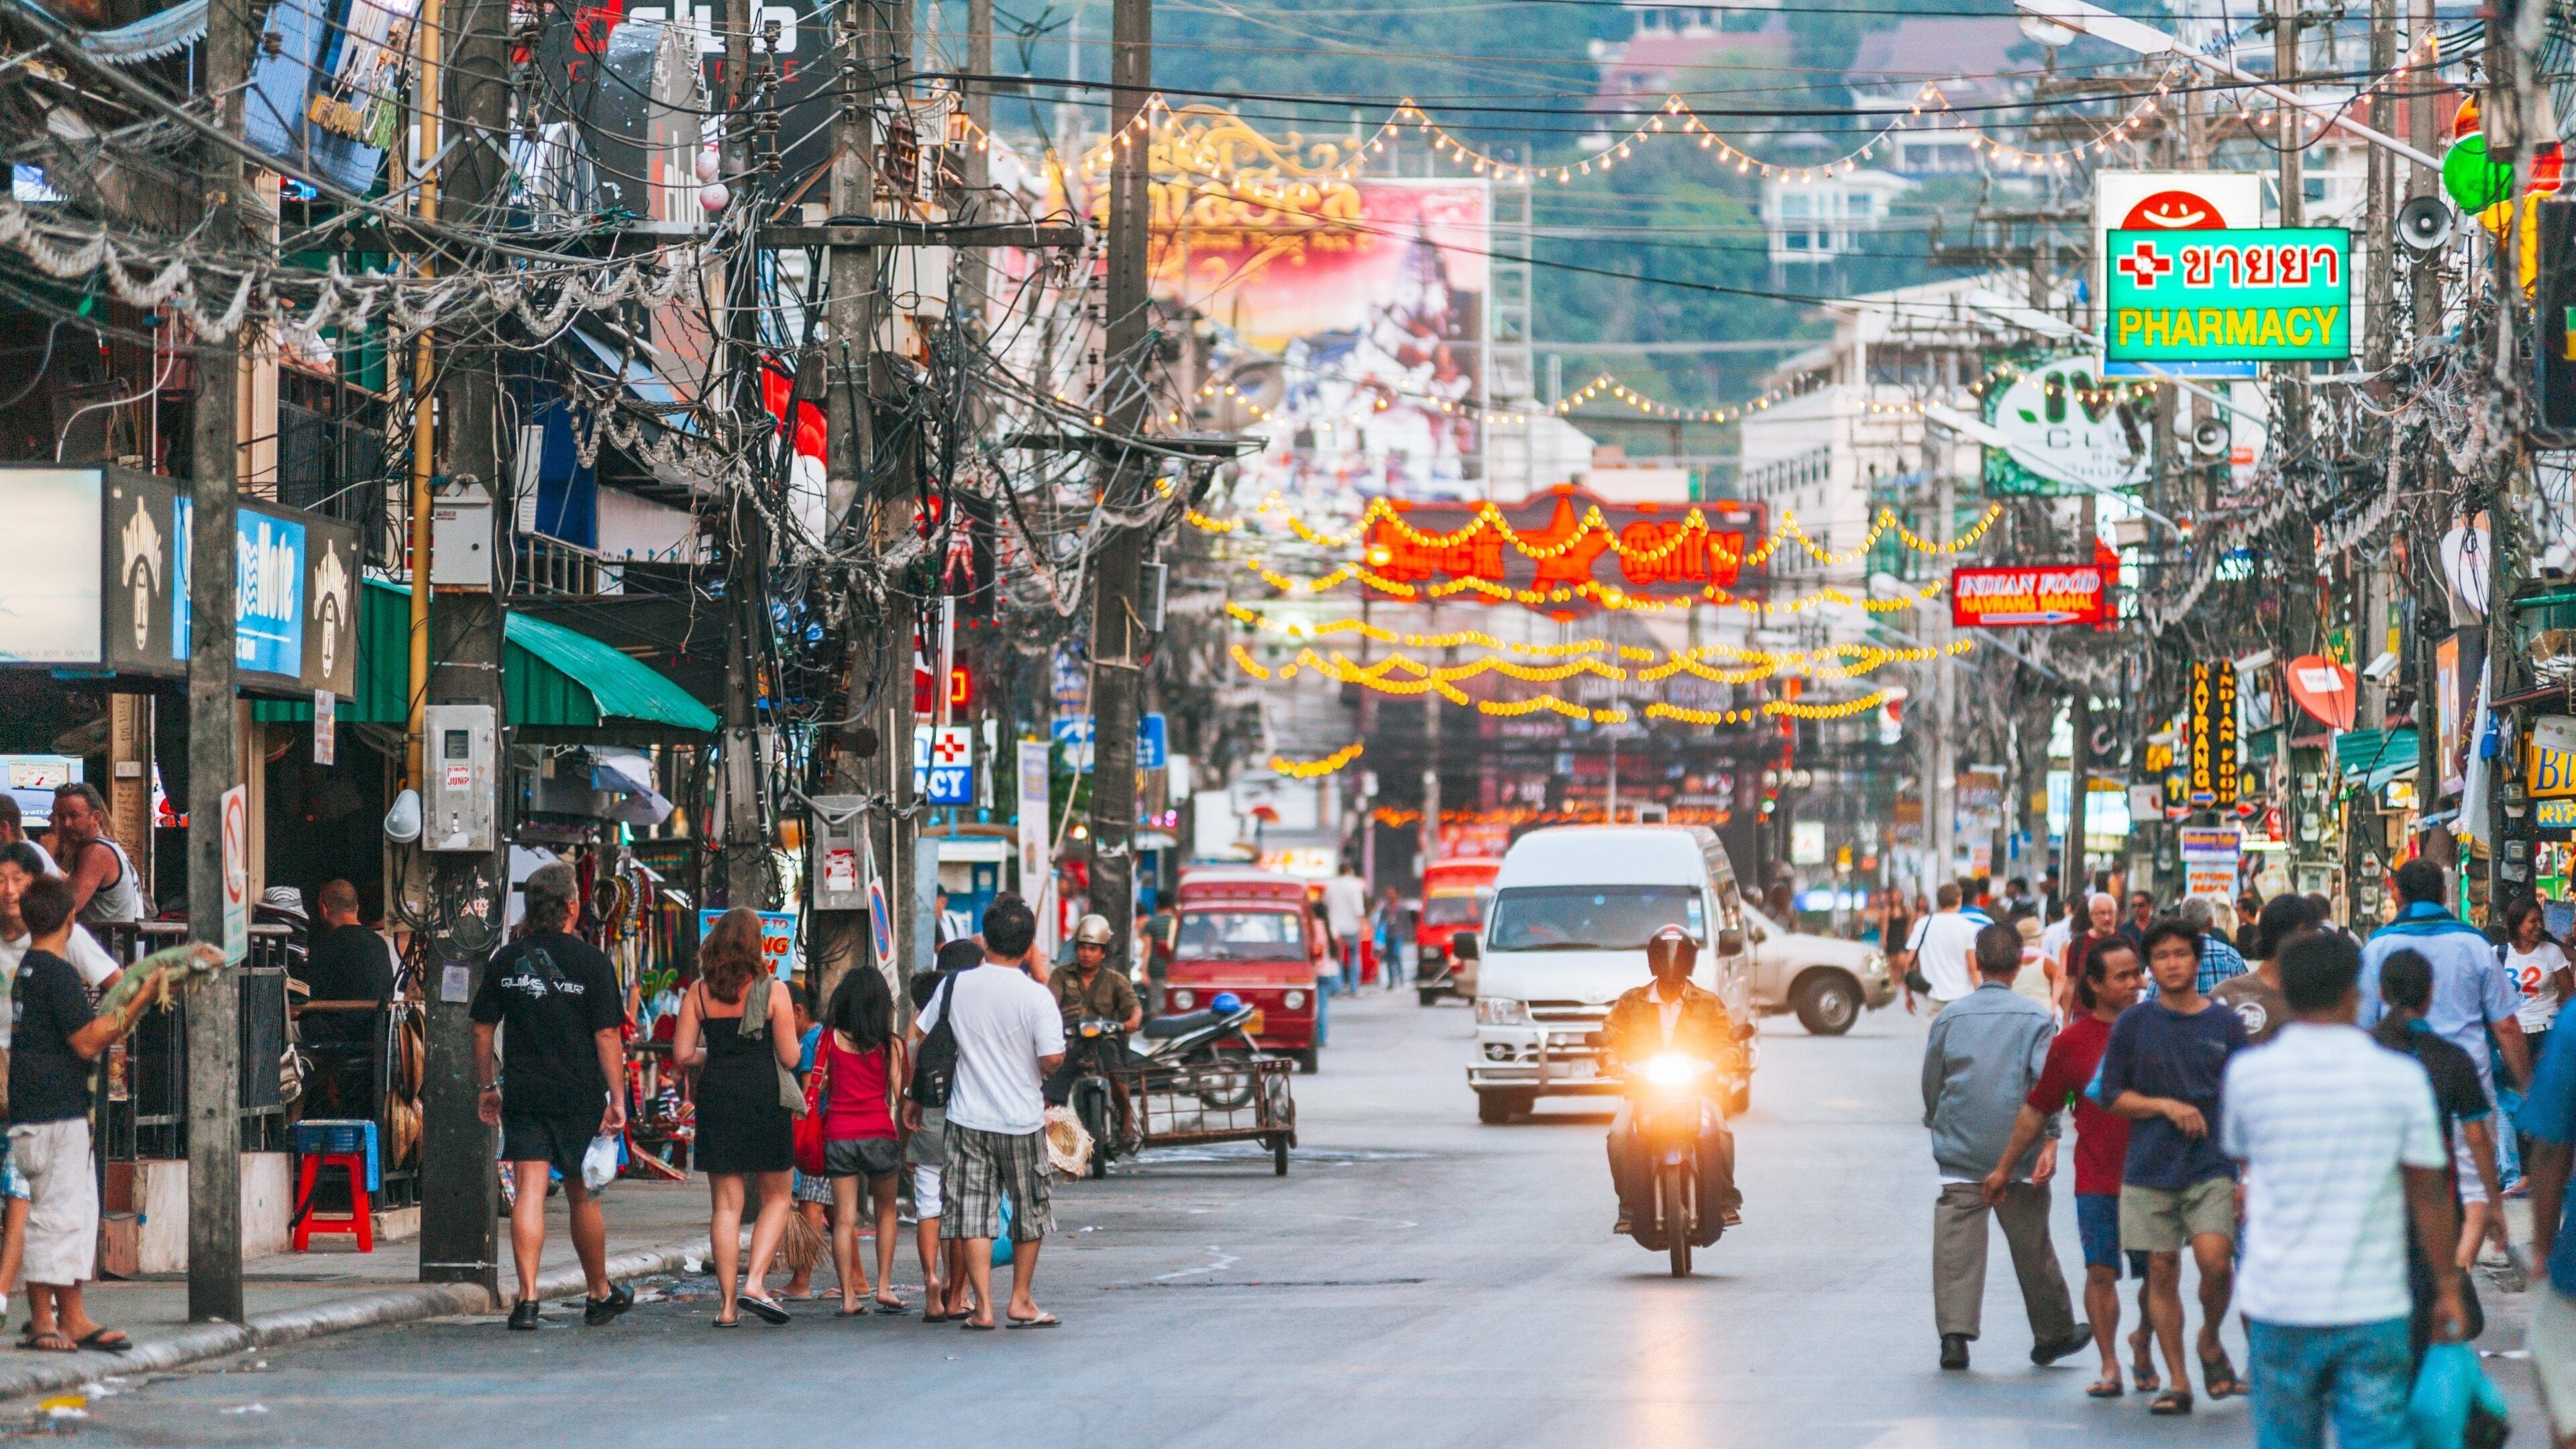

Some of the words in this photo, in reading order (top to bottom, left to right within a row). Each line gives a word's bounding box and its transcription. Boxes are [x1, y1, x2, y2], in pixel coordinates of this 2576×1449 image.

[2182, 246, 2339, 286] ขายยา
[2118, 305, 2339, 347] PHARMACY
[1957, 574, 2037, 596] INDIAN
[2037, 570, 2100, 595] FOOD
[1961, 594, 2037, 612] NAVRANG
[2040, 594, 2096, 611] MAHAL
[2219, 661, 2235, 742] INDIAN
[2194, 662, 2210, 788] NAVRANG
[447, 777, 469, 786] JUMP
